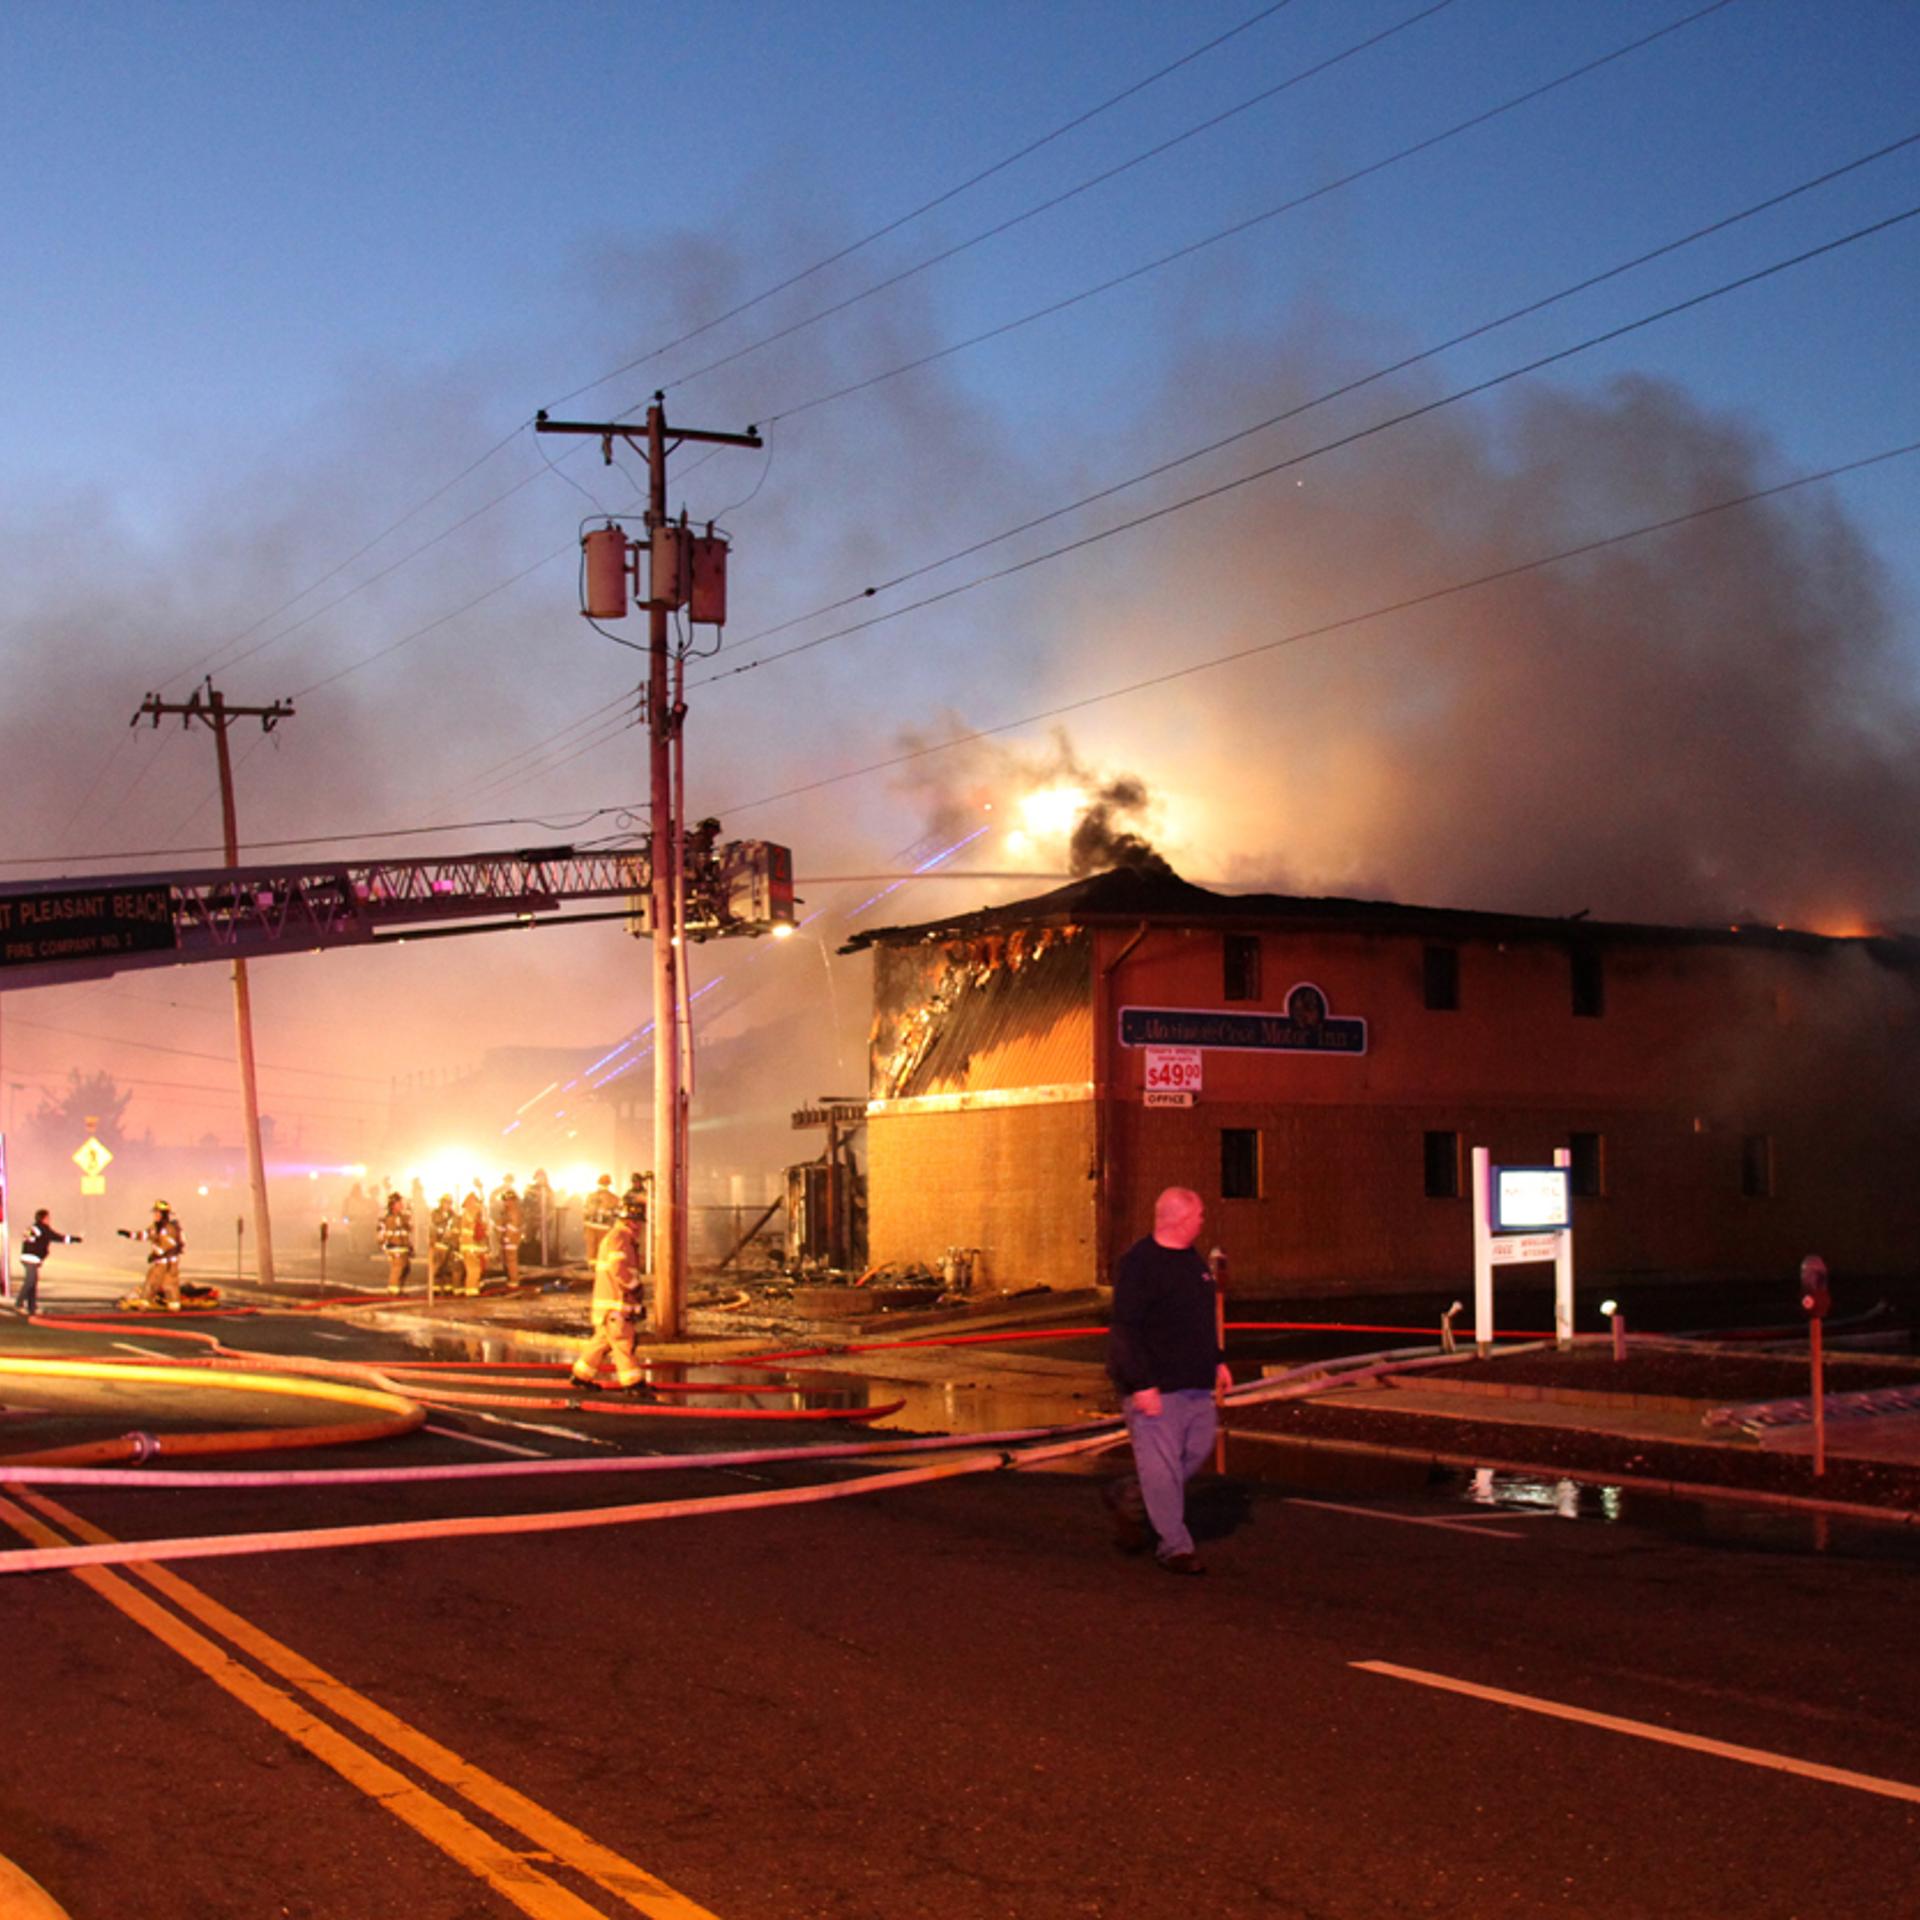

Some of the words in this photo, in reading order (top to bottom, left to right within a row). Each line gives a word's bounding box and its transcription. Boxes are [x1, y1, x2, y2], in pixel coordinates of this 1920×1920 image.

[19, 896, 105, 924] PLEASANT
[113, 892, 168, 922] BEACH
[1148, 1094, 1185, 1105] OFFICE
